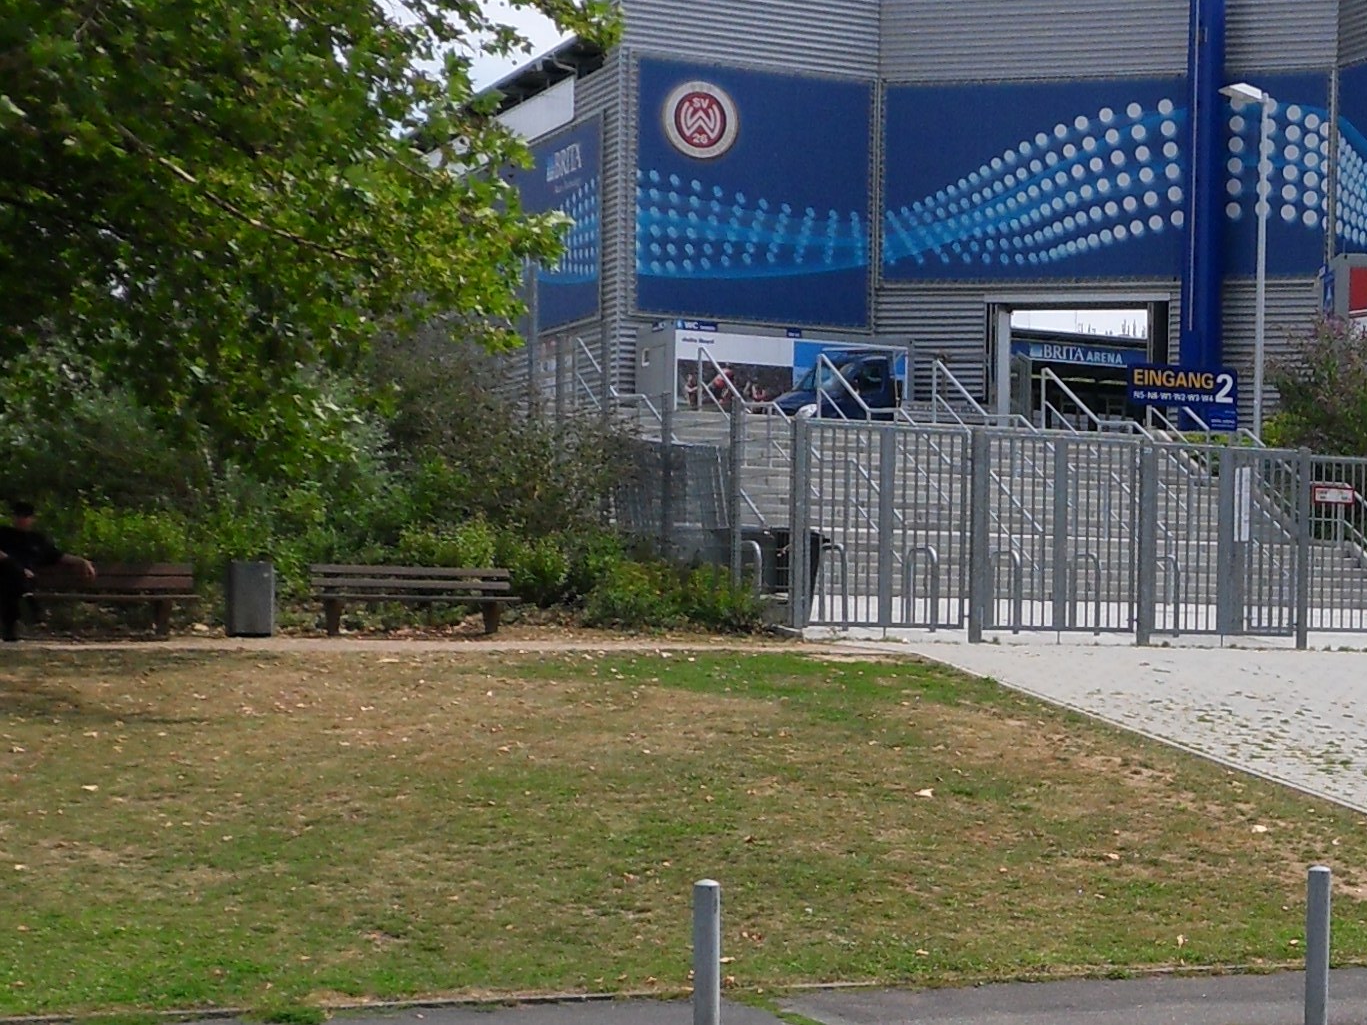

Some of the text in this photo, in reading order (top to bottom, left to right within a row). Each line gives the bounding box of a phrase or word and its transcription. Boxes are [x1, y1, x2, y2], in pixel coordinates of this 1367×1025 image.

[692, 97, 709, 108] SV
[554, 144, 582, 179] BRITA
[1043, 344, 1122, 364] BRITA ARENA
[1133, 368, 1233, 403] EINGANG 2
